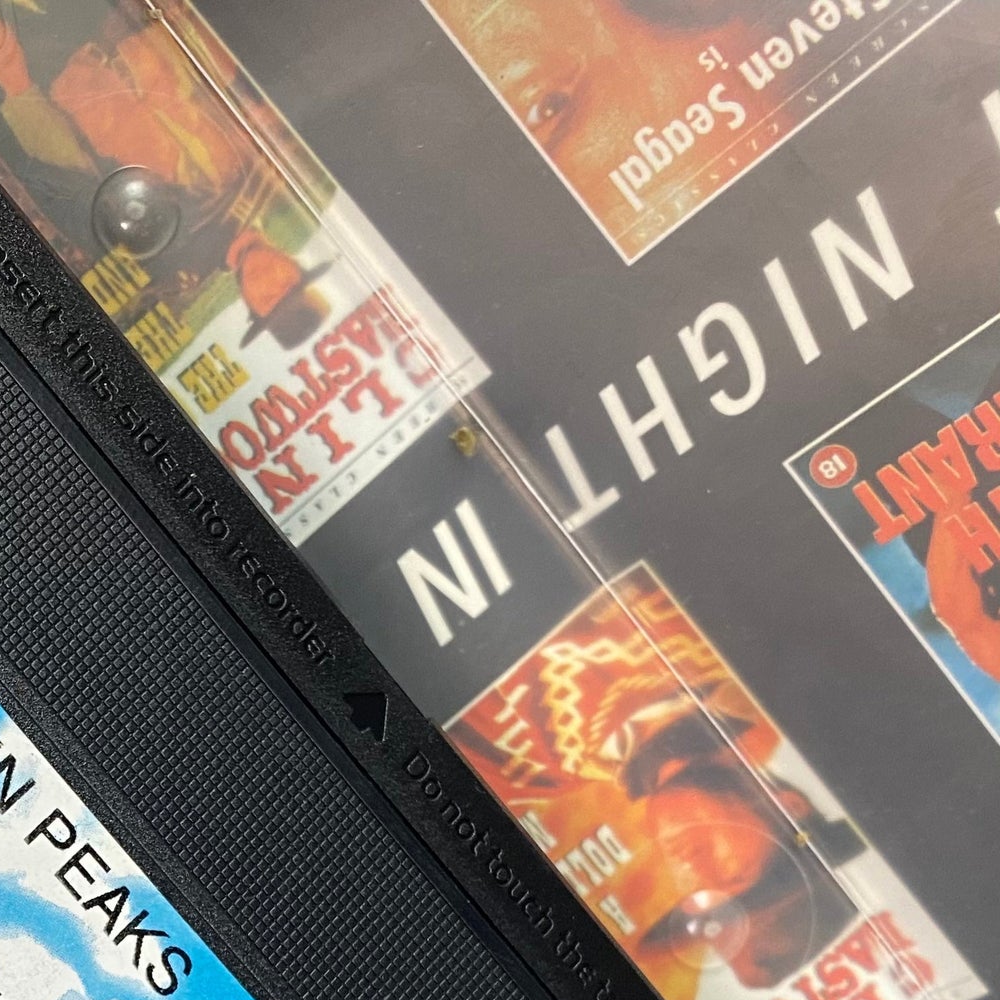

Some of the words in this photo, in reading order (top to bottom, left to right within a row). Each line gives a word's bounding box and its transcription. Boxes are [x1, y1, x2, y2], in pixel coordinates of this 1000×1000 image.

[698, 45, 728, 73] is
[741, 0, 891, 91] teven
[609, 82, 747, 211] Seagal
[546, 186, 914, 531] NIGHT
[60, 329, 121, 402] this
[117, 402, 180, 475] side
[174, 472, 230, 540] into
[227, 539, 336, 666] recorder
[818, 452, 846, 480] 18
[851, 391, 1000, 542] RANT
[397, 497, 510, 646] IN
[23, 807, 192, 996] PEAKS
[404, 753, 446, 799] Do
[441, 796, 494, 849] not
[487, 842, 556, 936] touch
[556, 928, 596, 983] the
